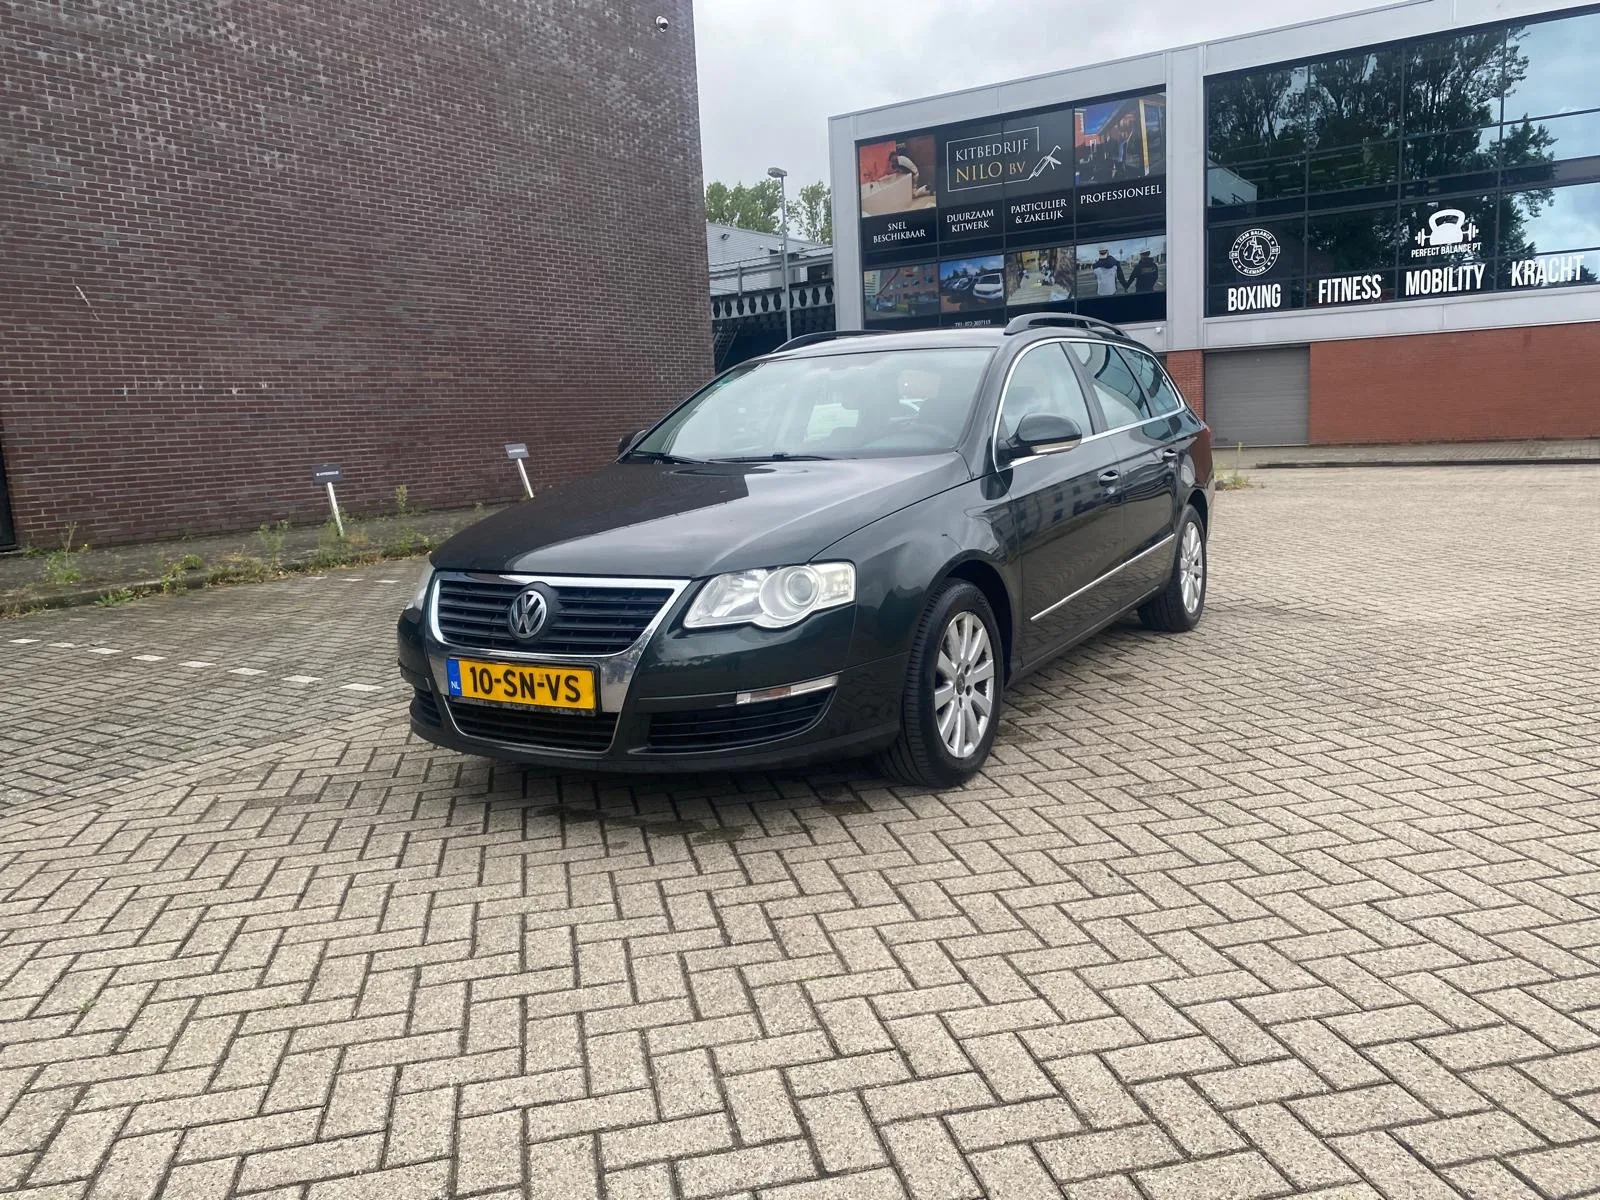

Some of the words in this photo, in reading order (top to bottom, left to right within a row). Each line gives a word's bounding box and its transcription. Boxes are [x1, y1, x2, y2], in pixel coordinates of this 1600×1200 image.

[956, 138, 1030, 161] KITBEDRIJF
[956, 162, 1002, 183] NILO
[1009, 161, 1026, 176] BV
[1080, 185, 1162, 204] PROFESSIONEEL
[1010, 198, 1067, 214] PARTICULIER
[946, 209, 994, 223] DUURZAAM
[1015, 215, 1023, 224] &
[1024, 209, 1064, 223] ZAKELIJK
[887, 221, 907, 232] SNEL
[951, 220, 989, 233] KITWERK
[873, 229, 926, 244] BESCHIKBAAR
[1237, 232, 1250, 243] TEAM
[1251, 231, 1272, 240] BALANCE
[1411, 247, 1440, 258] PERFECT
[1441, 243, 1471, 255] BALANCE
[1472, 242, 1482, 251] PT
[1511, 254, 1585, 287] KRACHT
[1405, 263, 1487, 296] MOBILITY
[1318, 273, 1382, 304] FITNESS
[1227, 283, 1281, 312] BOXING
[450, 680, 461, 690] NL
[469, 666, 581, 703] 10-SN-VS
